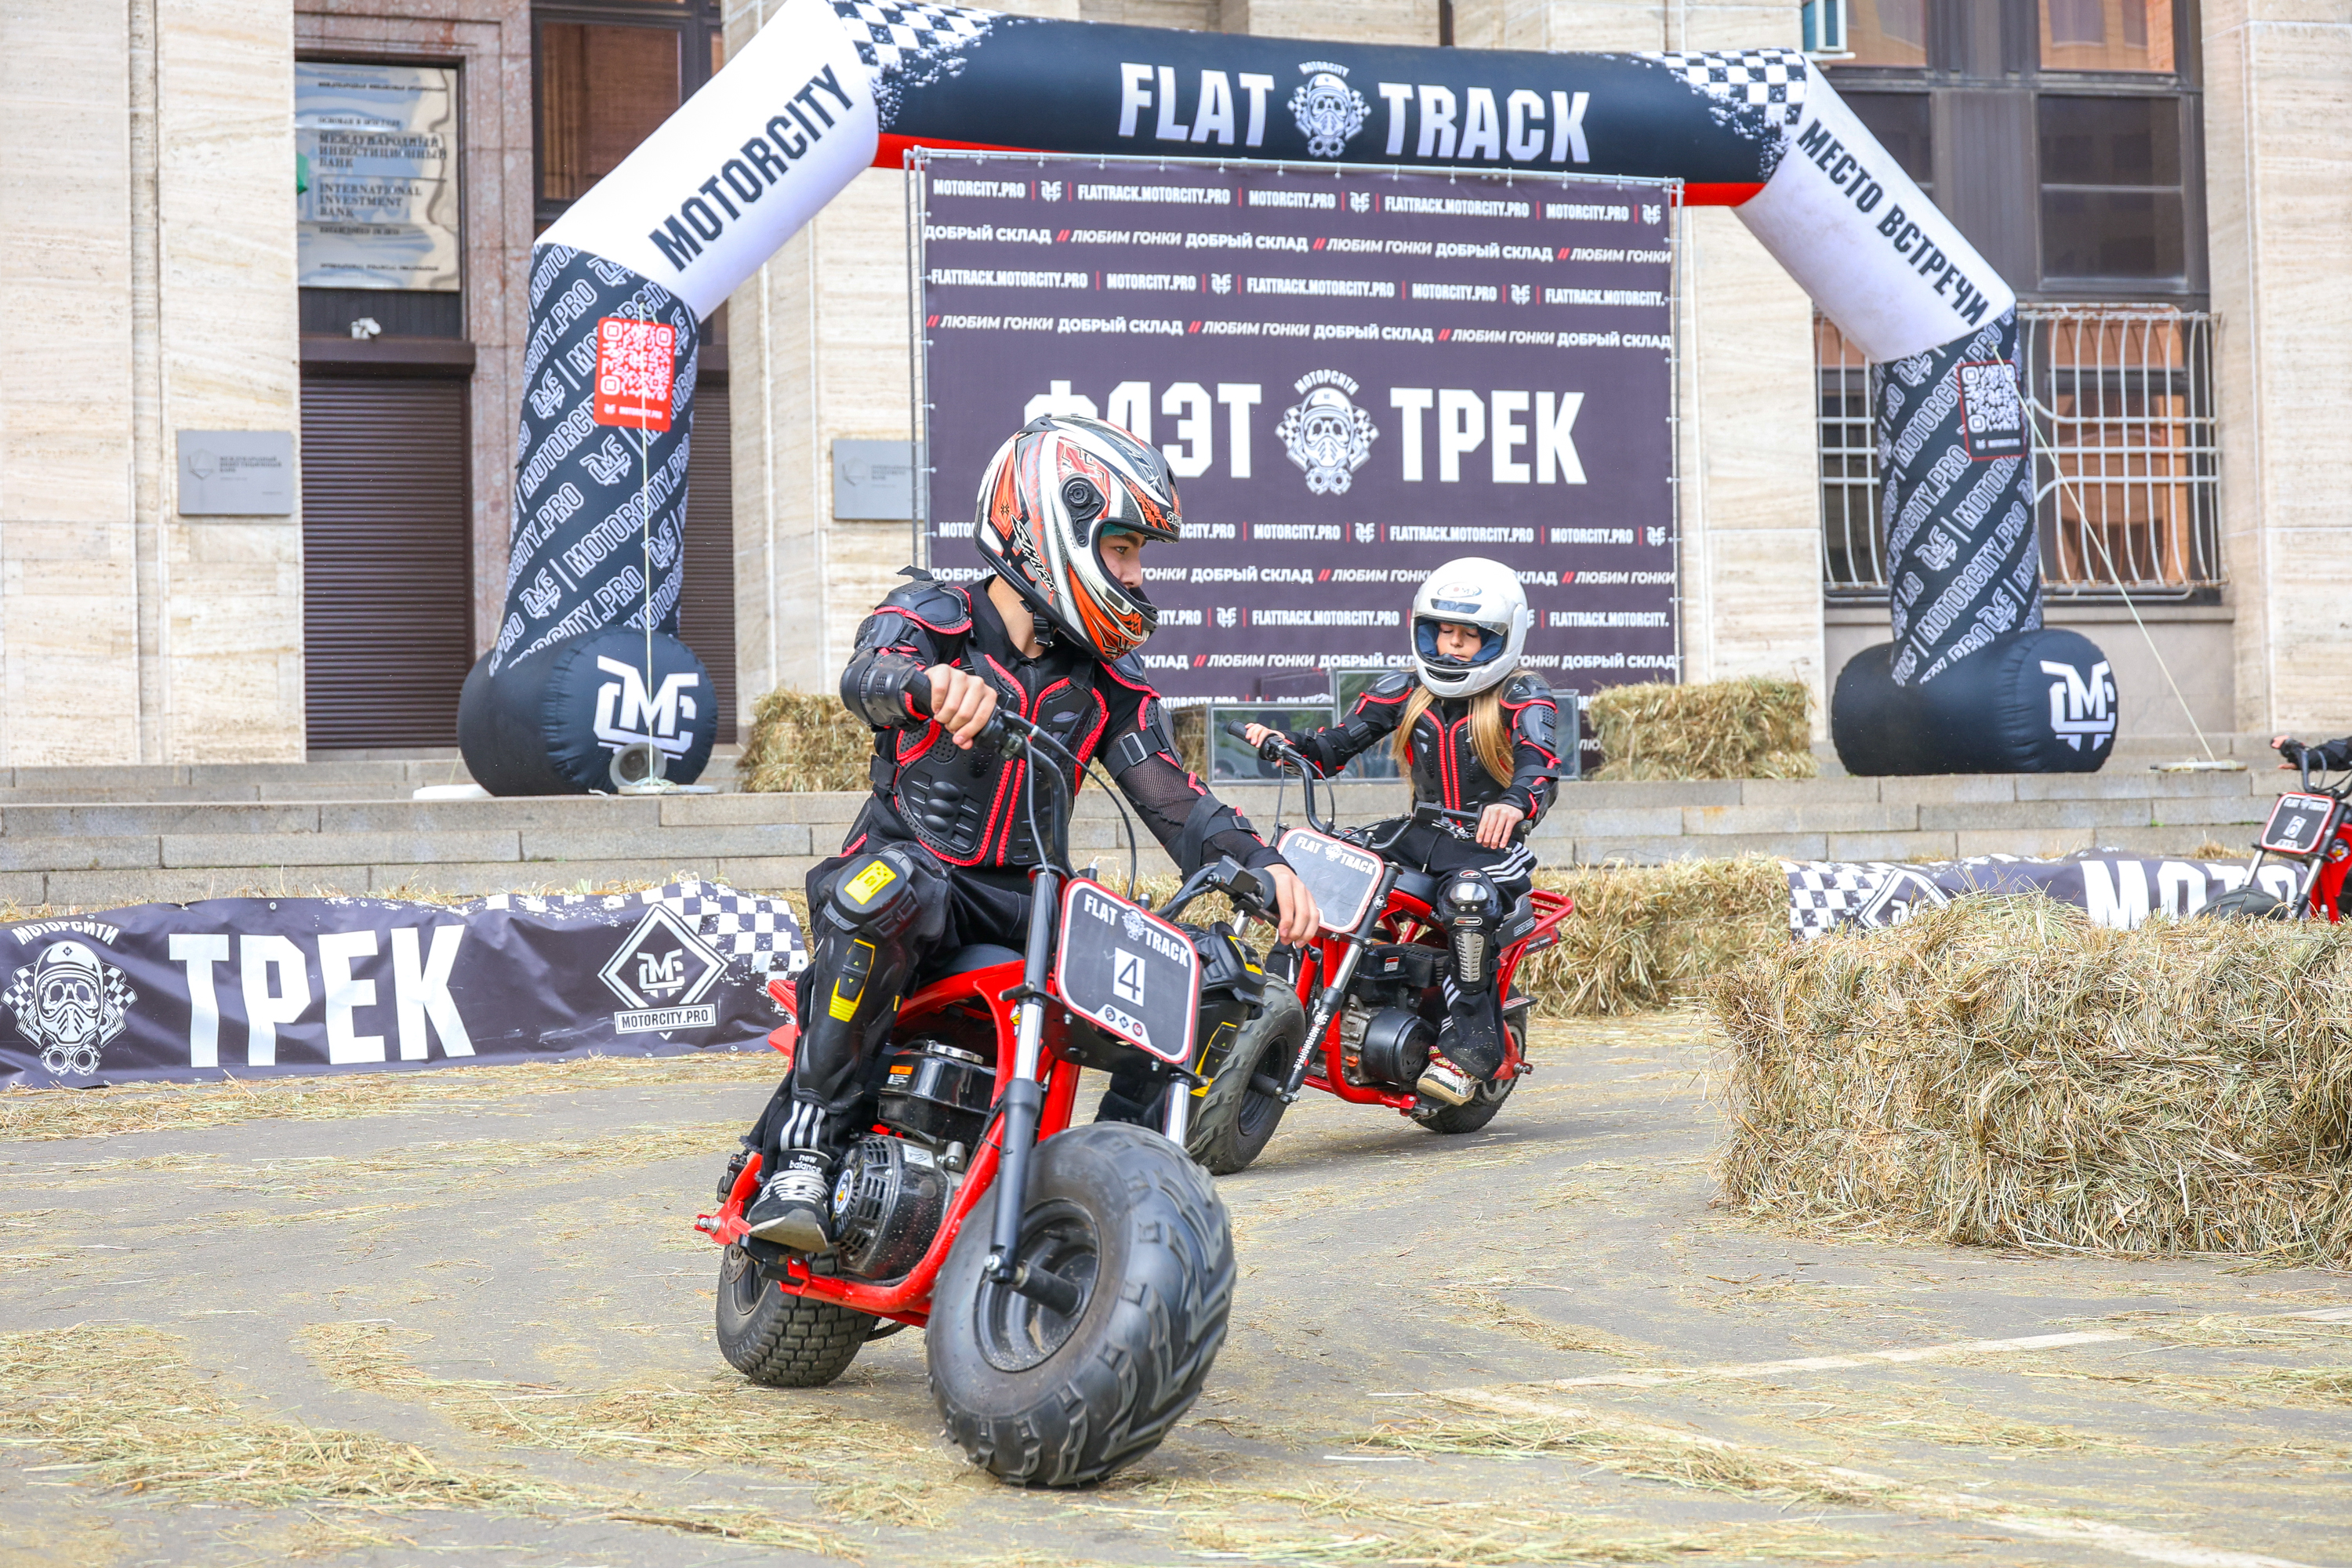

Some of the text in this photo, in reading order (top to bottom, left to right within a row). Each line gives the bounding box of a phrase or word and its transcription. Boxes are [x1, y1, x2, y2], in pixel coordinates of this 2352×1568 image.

[1118, 62, 1591, 163] FLAT TRACK
[648, 63, 854, 272] MOTORCITY
[319, 182, 422, 196] INTERNATIONAL
[319, 194, 403, 208] INVESTMENT
[933, 179, 1025, 198] MOTORCITY.PRO
[1078, 184, 1230, 205] FLATTRACK.MOTORCITY.PRO
[1249, 190, 1336, 209] MOTORCITY.PRO
[1385, 196, 1529, 218] FLATTRACK.MOTORCITY.PRO
[1546, 203, 1629, 222] MOTORCITY.PRO
[320, 205, 354, 218] BANK
[1796, 117, 1884, 213] МЕСТО
[1876, 202, 1989, 327] ВСТРЕЧИ
[924, 224, 1671, 264] ДОБРЫЙ СКЛАД ЛЮБИМ ГОНКИ ДОБРЫЙ СКЛАД ЛЮБИМ ГОНКИ ДОБРЫЙ СКЛАД ЛЮБИМ ГОНКИ
[931, 268, 1088, 290] FLATTRACK.MOTORCITY.PRO
[1107, 274, 1196, 292] MOTORCITY.PRO
[1247, 277, 1395, 298] FLATTRACK.MOTORCITY.PRO
[1412, 283, 1497, 302] MOTORCITY.PRO
[940, 315, 1671, 350] ЛЮБИМ ГОНКИ ДОБРЫЙ СКЛАД ЛЮБИМ ГОНКИ ДОБРЫЙ СКЛАД ЛЮБИМ ГОНКИ ДОБРЫЙ СКЛАД
[1390, 387, 1588, 485] ТРЕК
[1254, 523, 1341, 541] MOTORCITY.PRO
[1390, 525, 1534, 543] FLATTRACK.MOTORCITY.PRO
[1551, 528, 1633, 544] MOTORCITY.PRO
[1191, 566, 1258, 583] ДОБРЫЙ
[1261, 568, 1313, 584] СКЛАД
[1331, 569, 1388, 583] ЛЮБИМ
[1517, 571, 1558, 586] КЛАД
[1575, 572, 1628, 584] ЛЮБИМ
[1631, 572, 1675, 585] ГОНКИ
[1915, 500, 2028, 646] MOTORCITY.PRO
[1252, 609, 1399, 626] FLATTRACK.MOTORCITY.PRO
[1141, 655, 1189, 670] КЛАД
[1207, 655, 1265, 667] ЛЮБИМ
[1268, 655, 1316, 667] ГОНКИ
[1318, 652, 1384, 668] ДОБРЫЙ
[1562, 652, 1624, 670] ДОБРЫЙ
[1627, 655, 1675, 670] СКЛАД
[2288, 818, 2303, 836] 6
[1294, 836, 1377, 876] FLAT TRACK
[11, 920, 120, 946] МОТОРСИТИ
[1083, 893, 1189, 967] FLAT TRACK
[1117, 957, 1142, 1000] 4
[169, 924, 476, 1069] ТРЕК
[622, 1009, 709, 1029] MOTORCITY.PRO
[789, 1160, 822, 1174] balance
[798, 1153, 818, 1164] new
